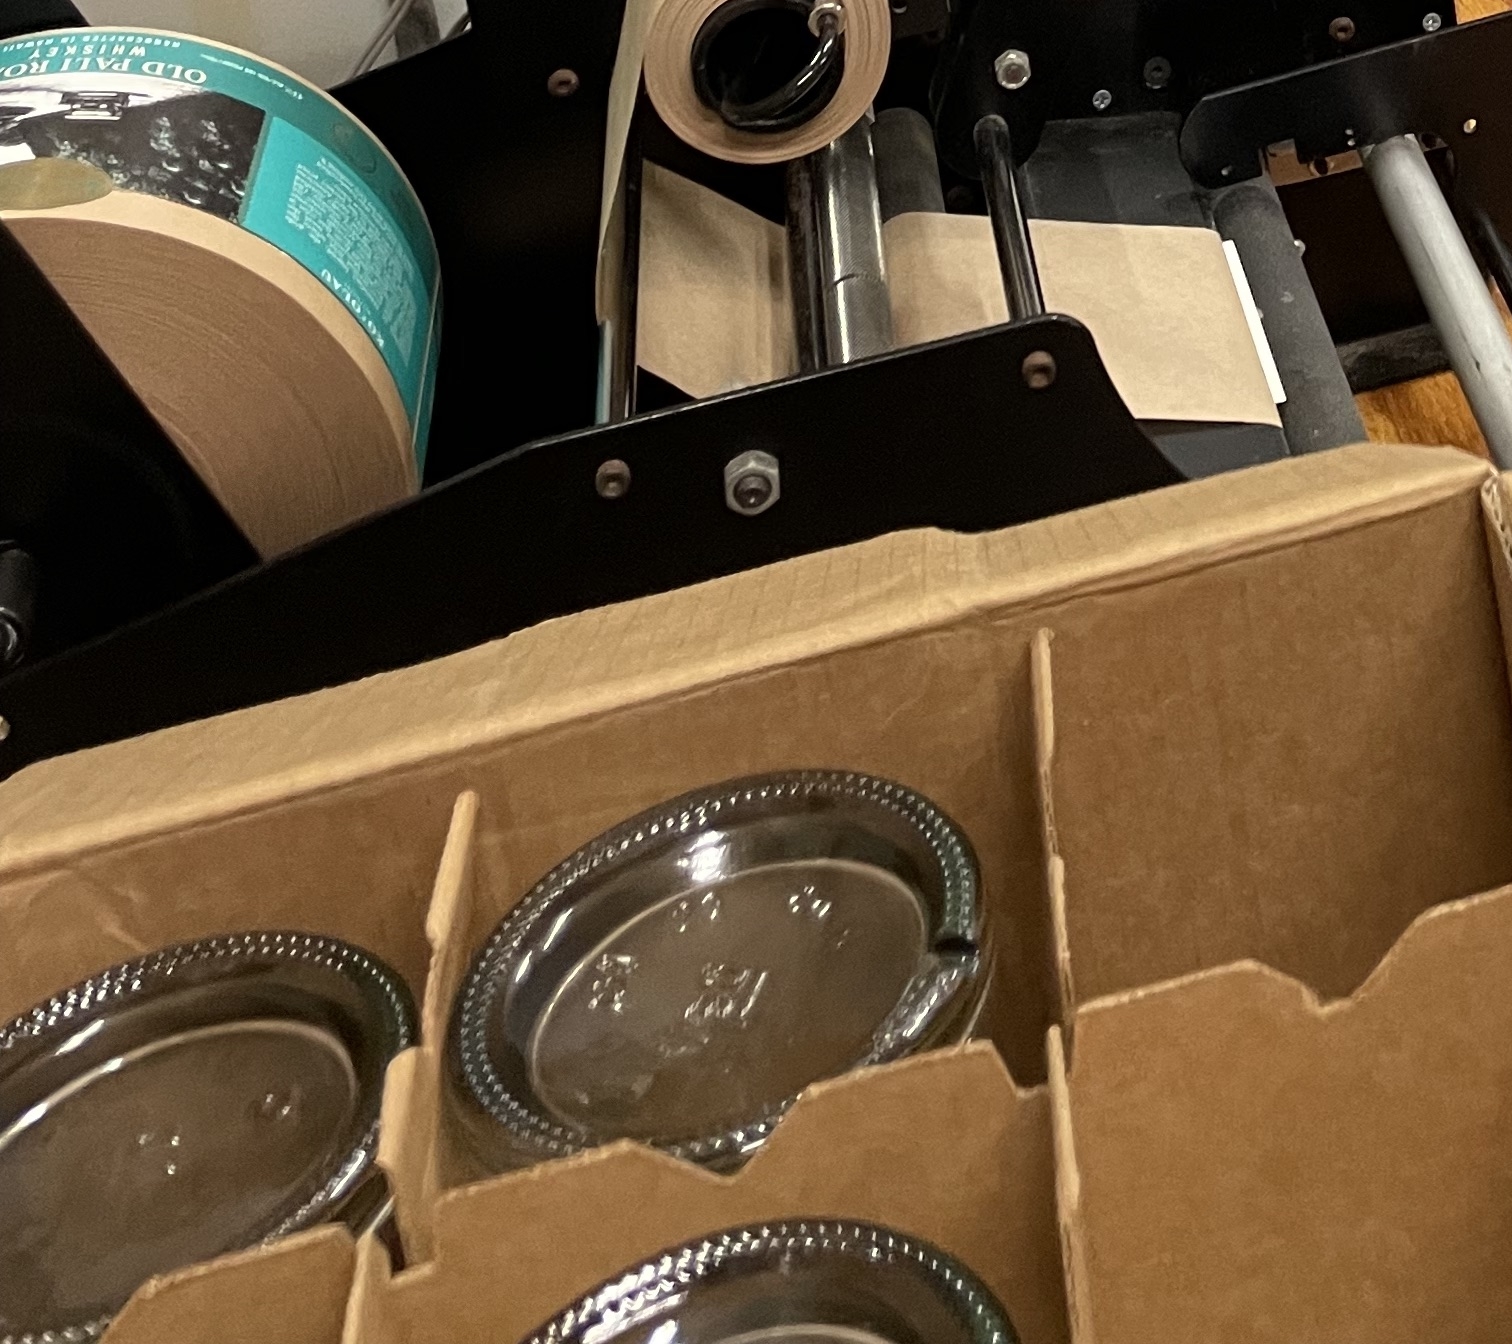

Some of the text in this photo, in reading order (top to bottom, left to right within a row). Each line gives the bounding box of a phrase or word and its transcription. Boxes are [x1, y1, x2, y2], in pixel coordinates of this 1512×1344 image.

[28, 44, 146, 60] WHISKEY
[61, 57, 132, 71] PALI
[142, 62, 207, 84] OLD
